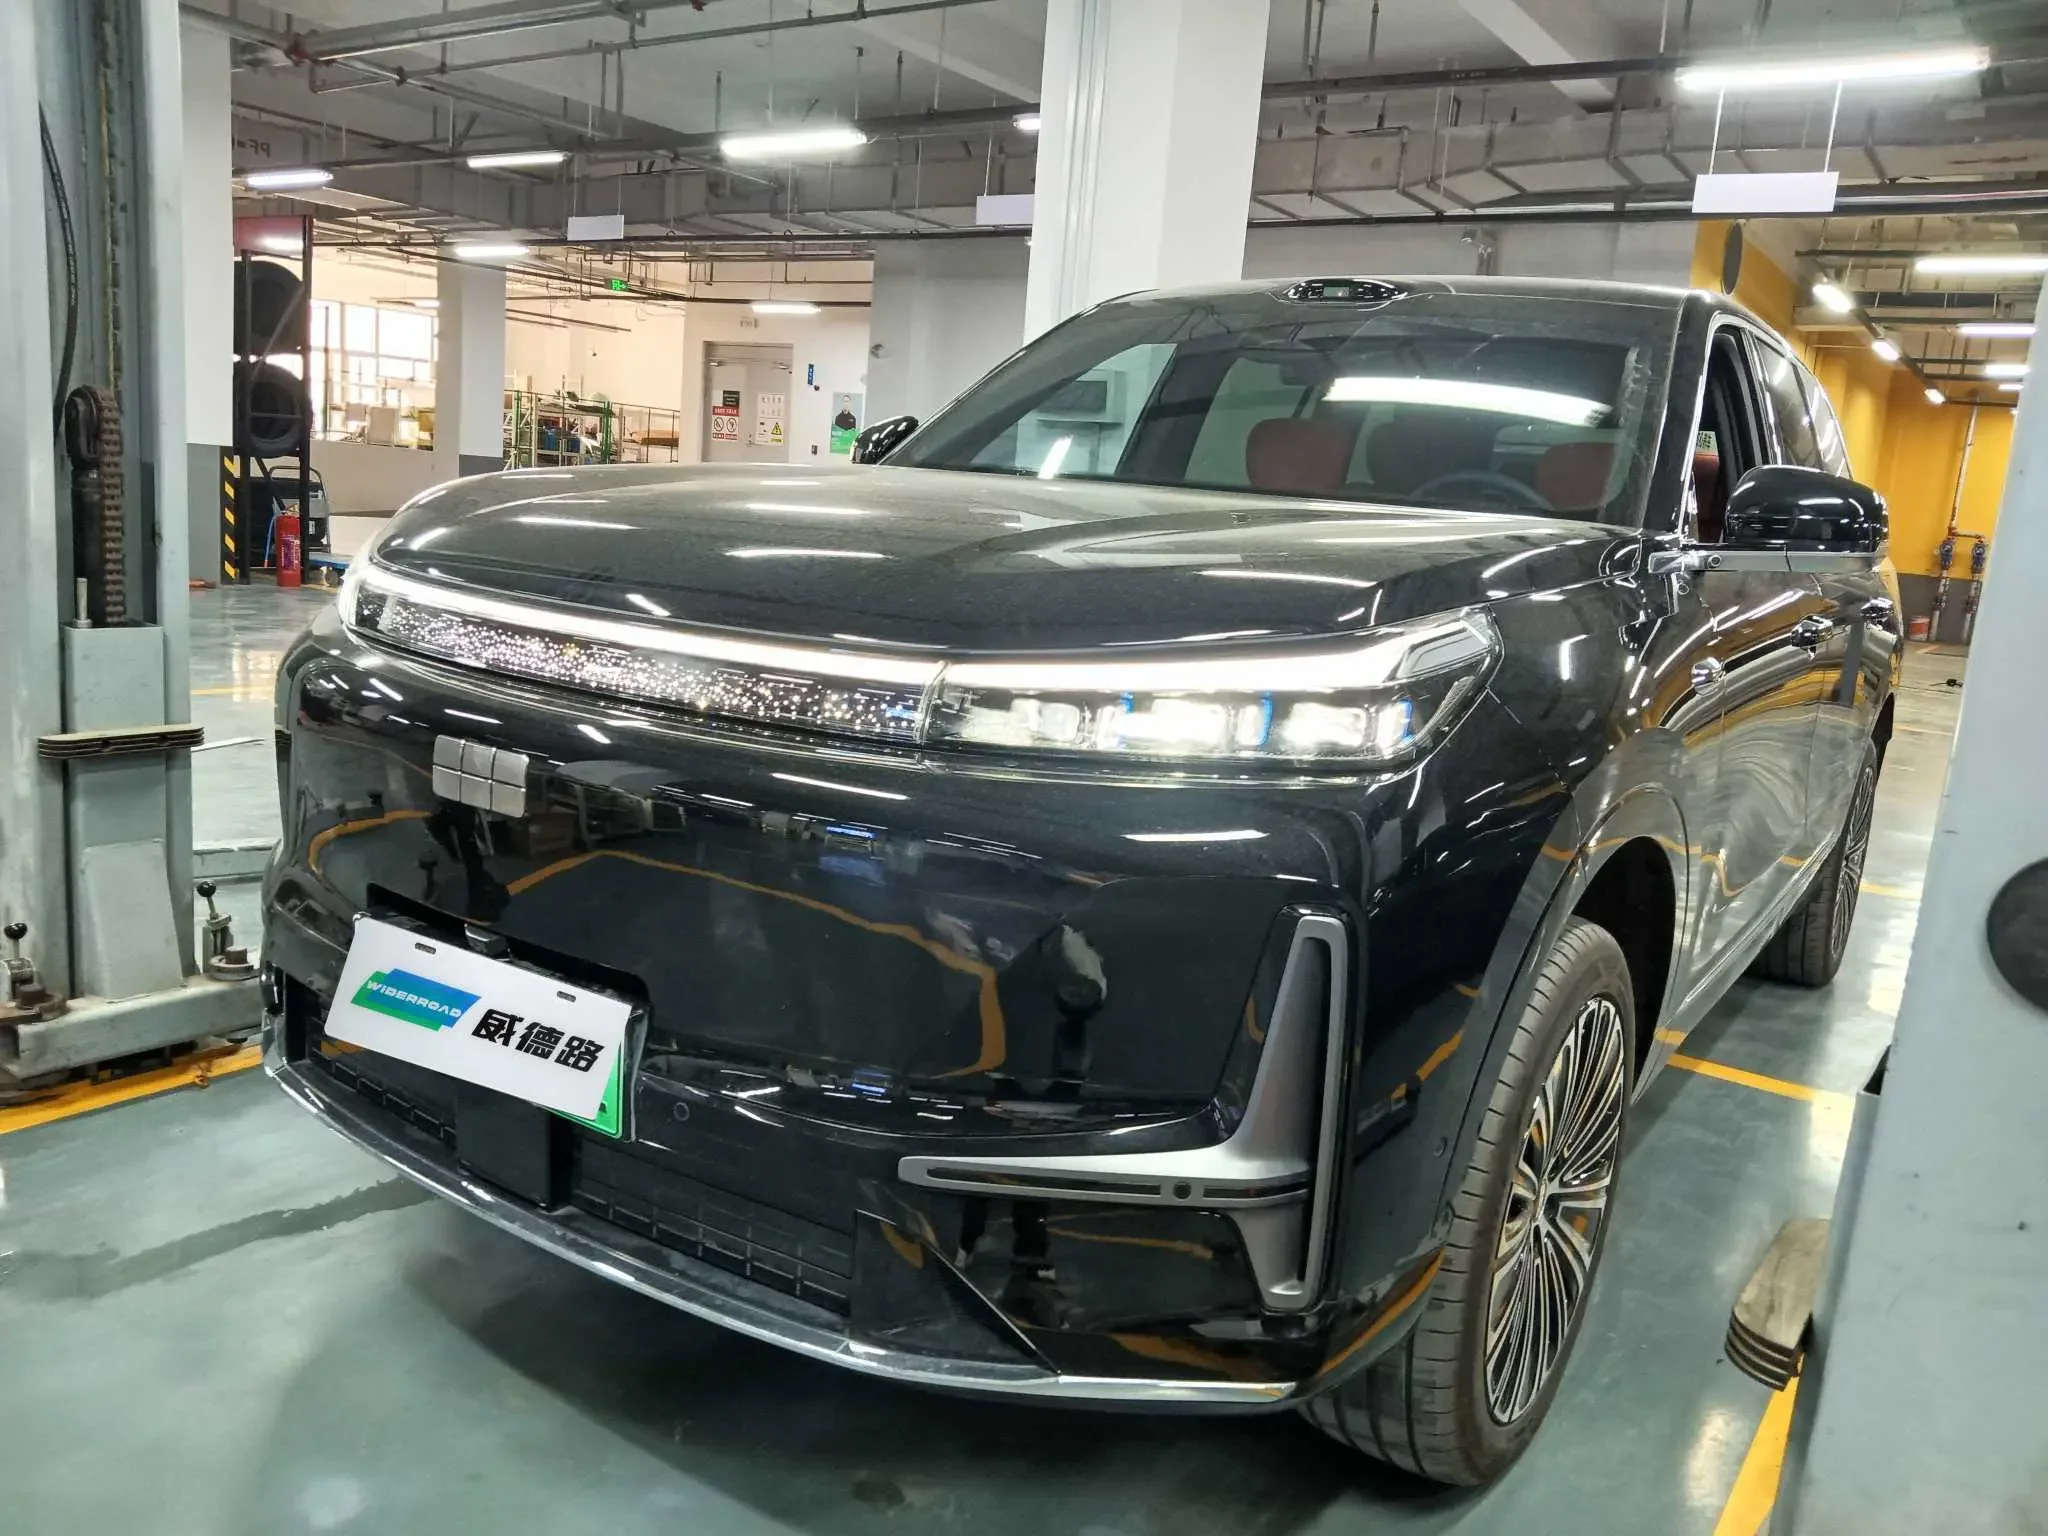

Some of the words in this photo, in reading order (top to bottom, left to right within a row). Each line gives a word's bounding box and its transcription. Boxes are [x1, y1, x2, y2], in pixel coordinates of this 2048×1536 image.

[367, 980, 462, 1018] WIDERROAD
[471, 1008, 605, 1072] 威德路
